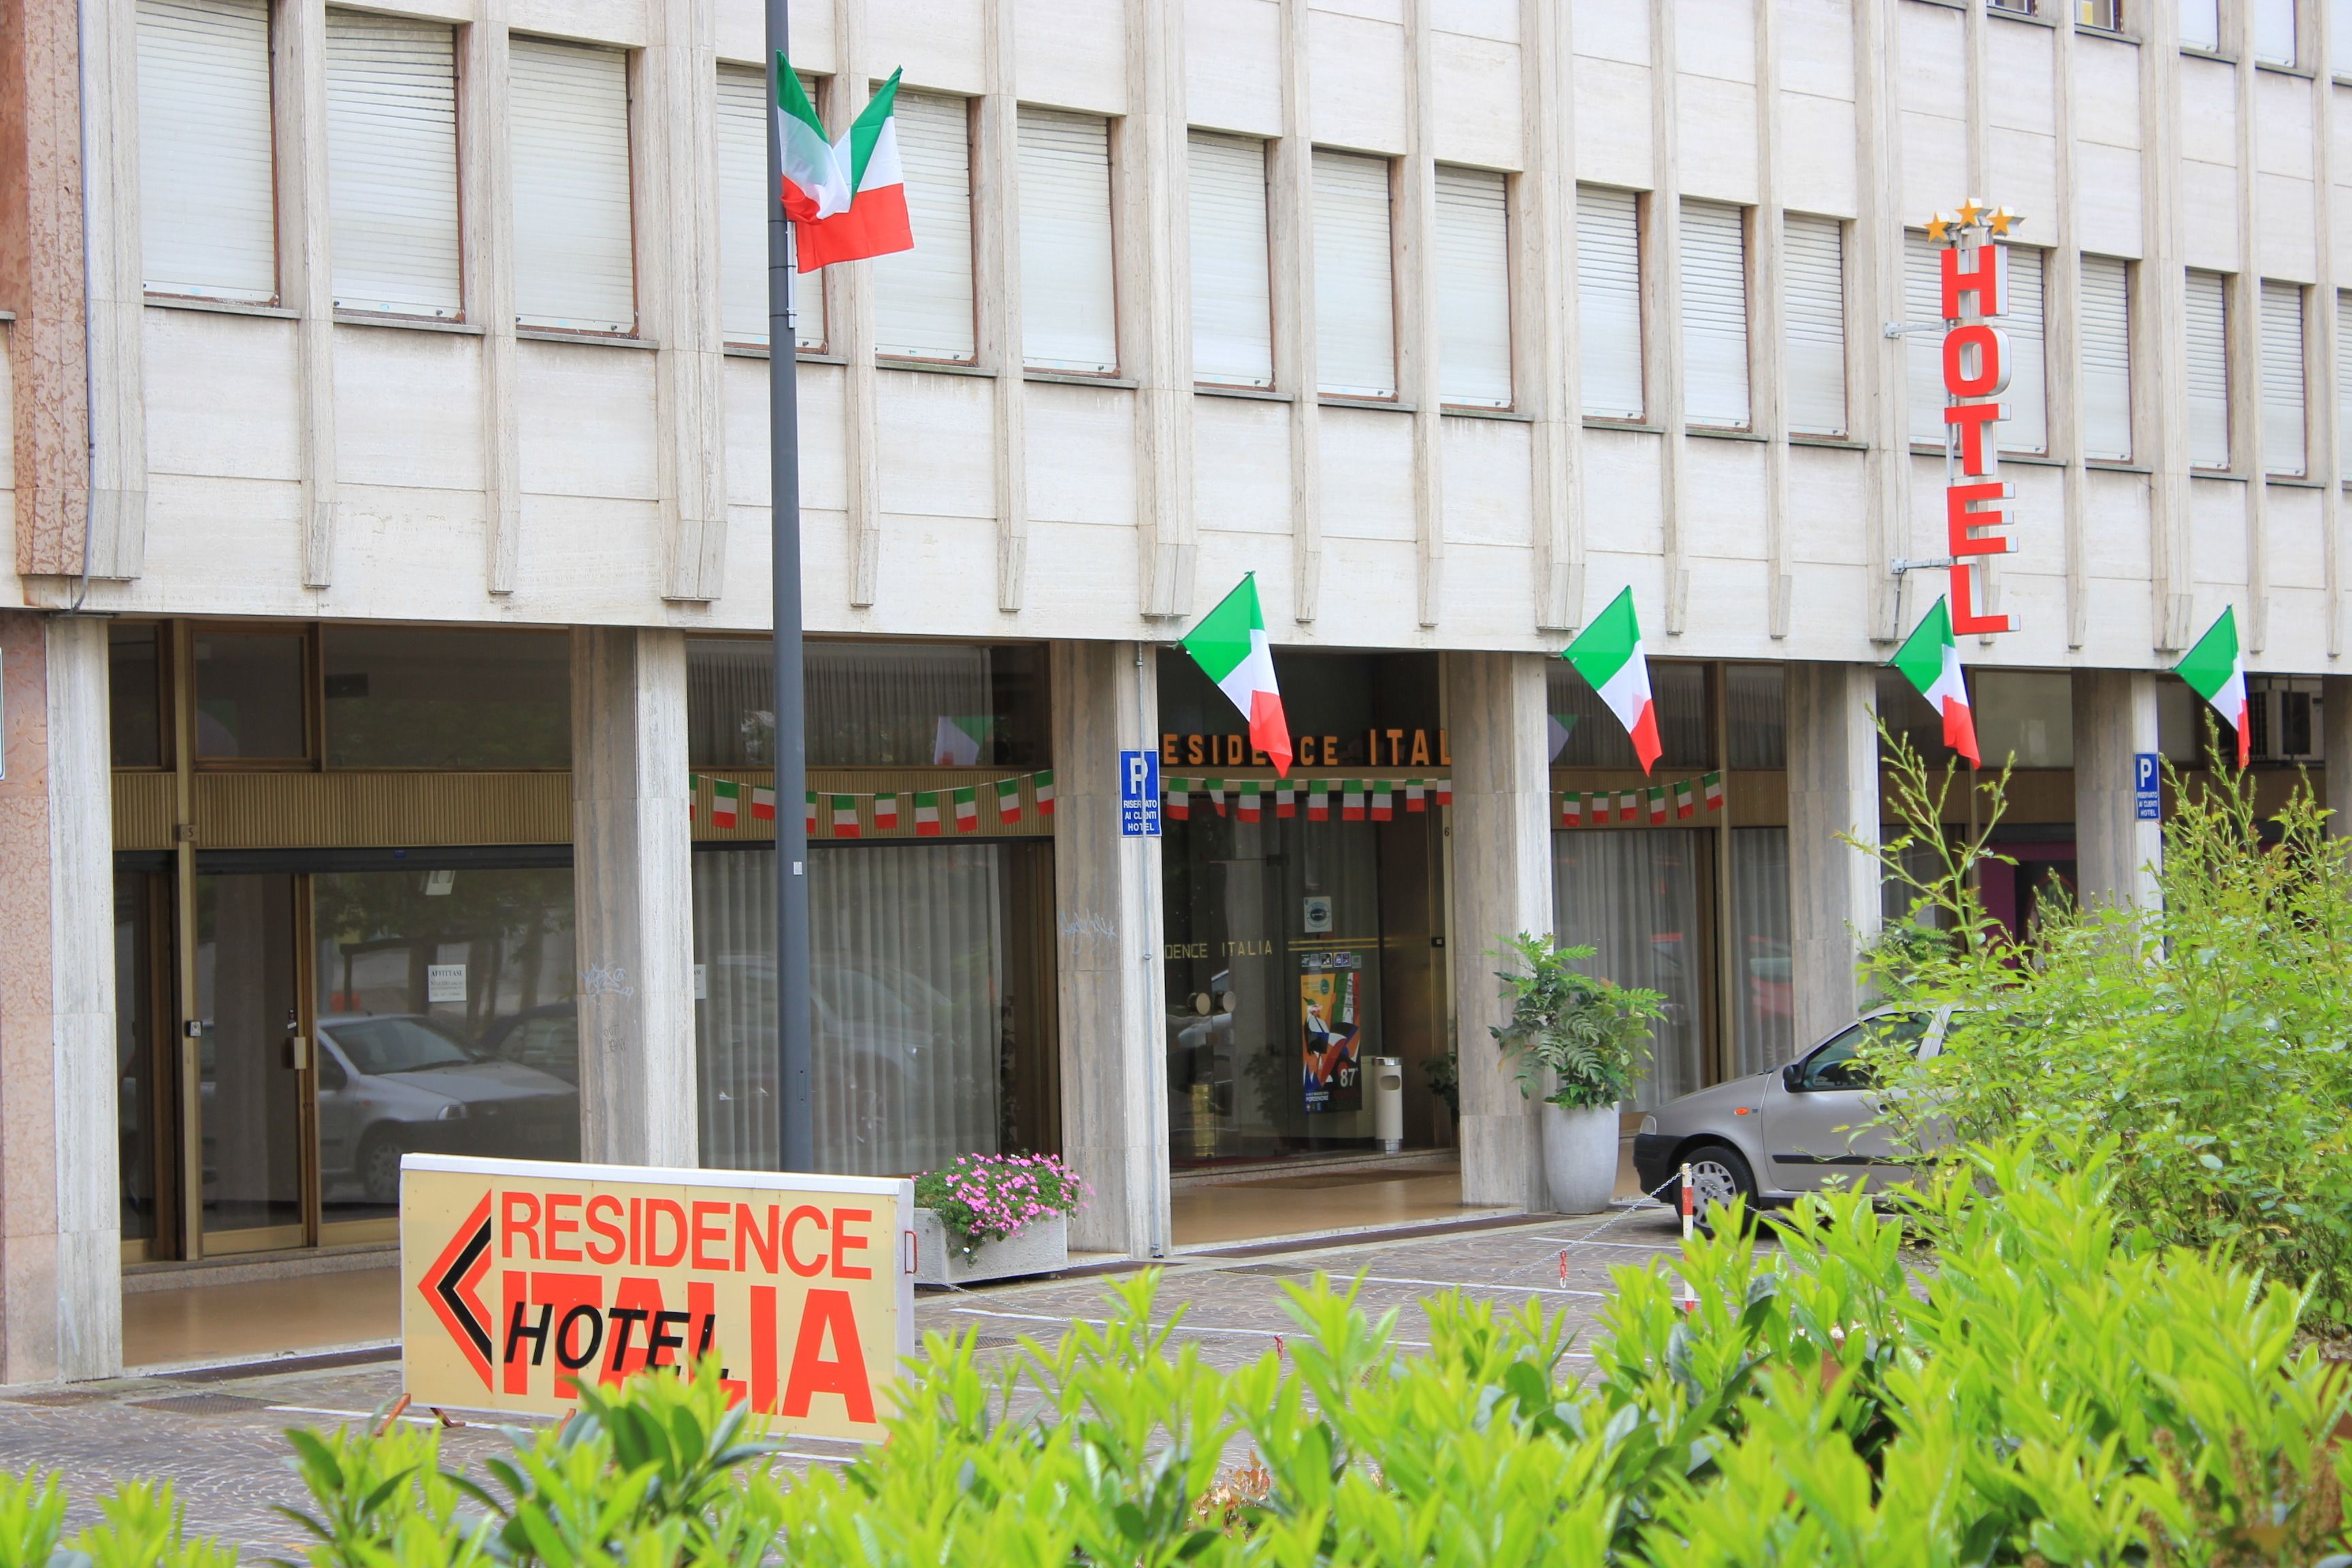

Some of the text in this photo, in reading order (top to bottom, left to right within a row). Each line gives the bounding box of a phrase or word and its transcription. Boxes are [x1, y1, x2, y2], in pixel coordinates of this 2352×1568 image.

[1941, 244, 2019, 636] HOTEL
[1370, 729, 1452, 766] ITAL
[1130, 757, 1148, 794] P
[2140, 758, 2152, 787] P
[1124, 800, 1157, 808] RISERATO
[1125, 811, 1132, 820] AI
[1128, 822, 1155, 832] HOTEL
[1444, 827, 1450, 836] 6
[1222, 940, 1272, 957] ITALIA
[502, 1191, 872, 1280] RESIDENCE
[503, 1270, 877, 1424] ITALIA
